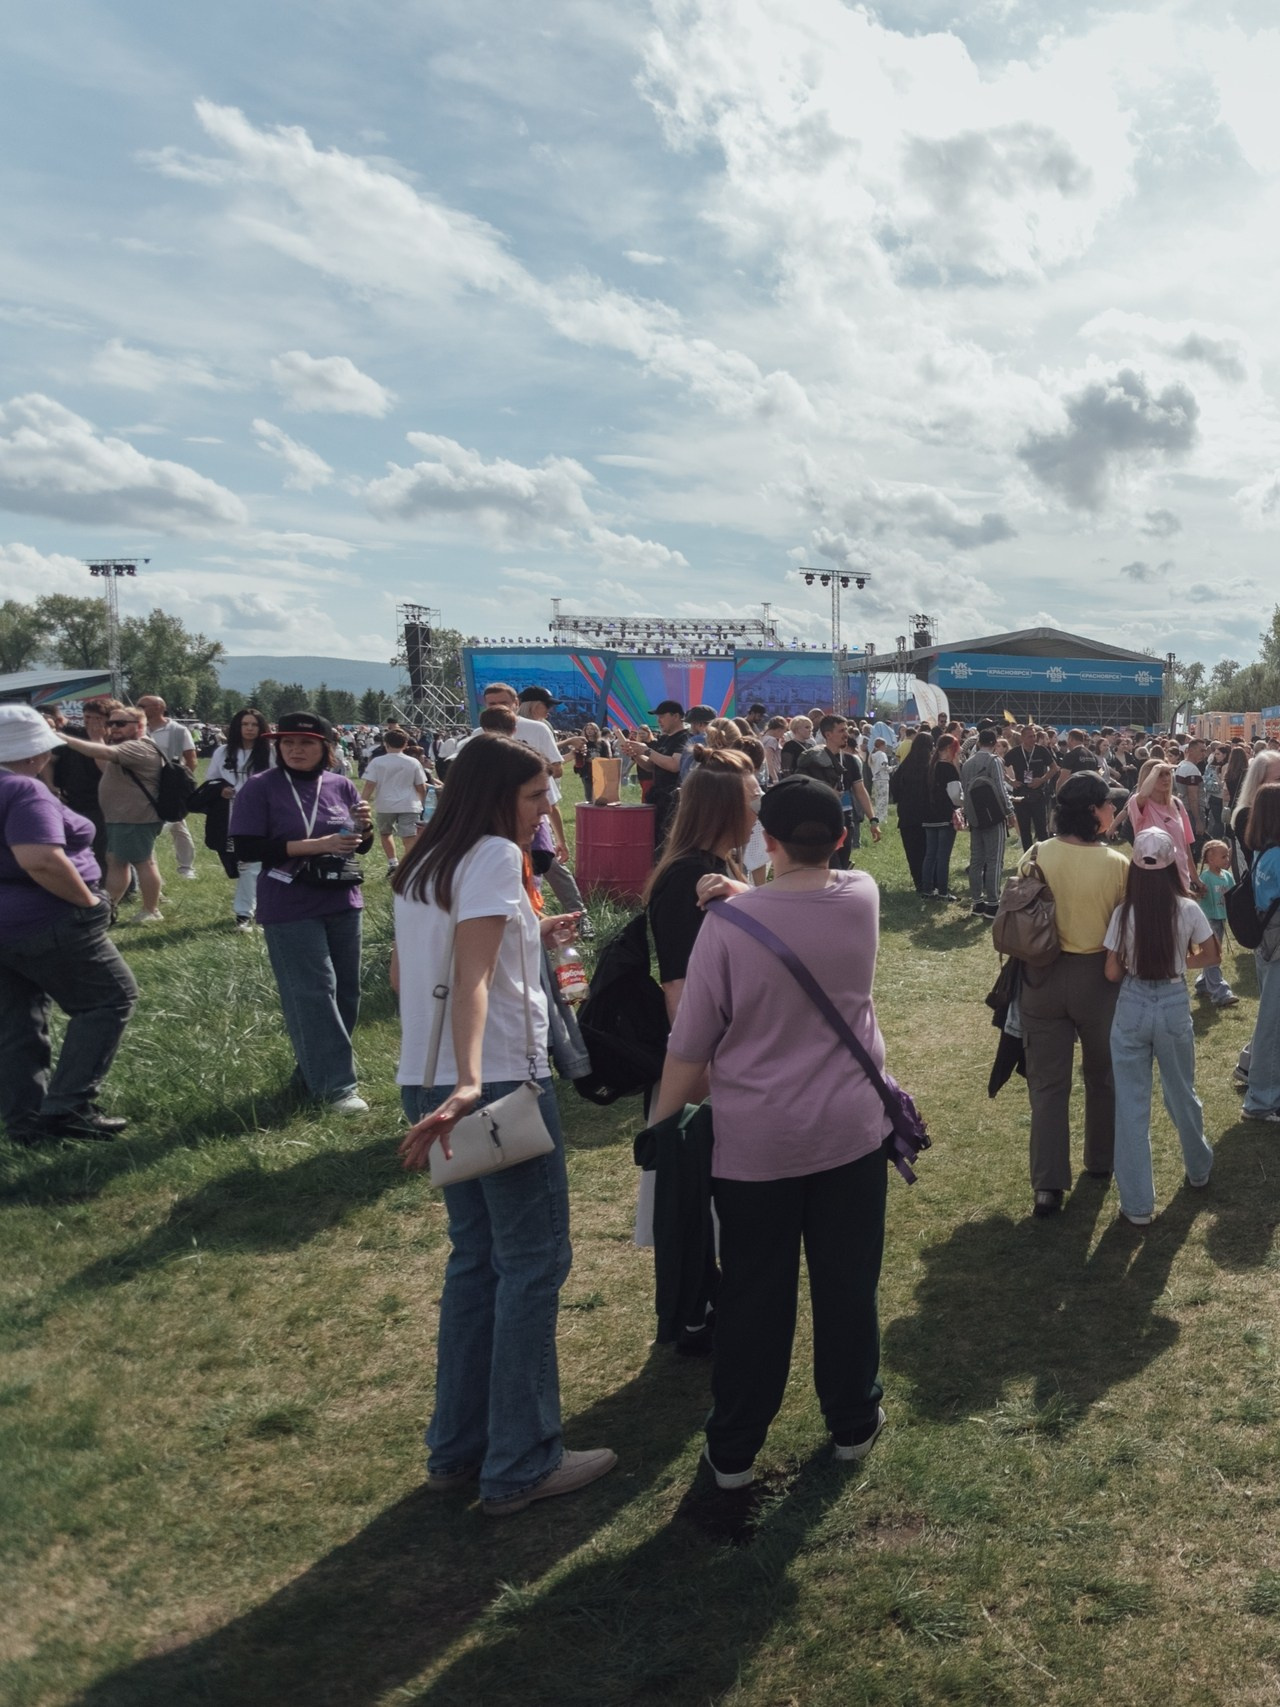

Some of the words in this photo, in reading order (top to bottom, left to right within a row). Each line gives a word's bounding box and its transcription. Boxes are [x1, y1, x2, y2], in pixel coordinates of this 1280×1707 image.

[955, 662, 968, 670] VK
[1050, 666, 1063, 674] VK
[951, 666, 973, 676] fest
[988, 669, 1030, 677] КРАСНОЯРСК
[1046, 670, 1067, 680] fest
[1081, 673, 1120, 681] КРАСНОЯРСК
[1134, 673, 1154, 684] fest
[62, 700, 84, 709] VK
